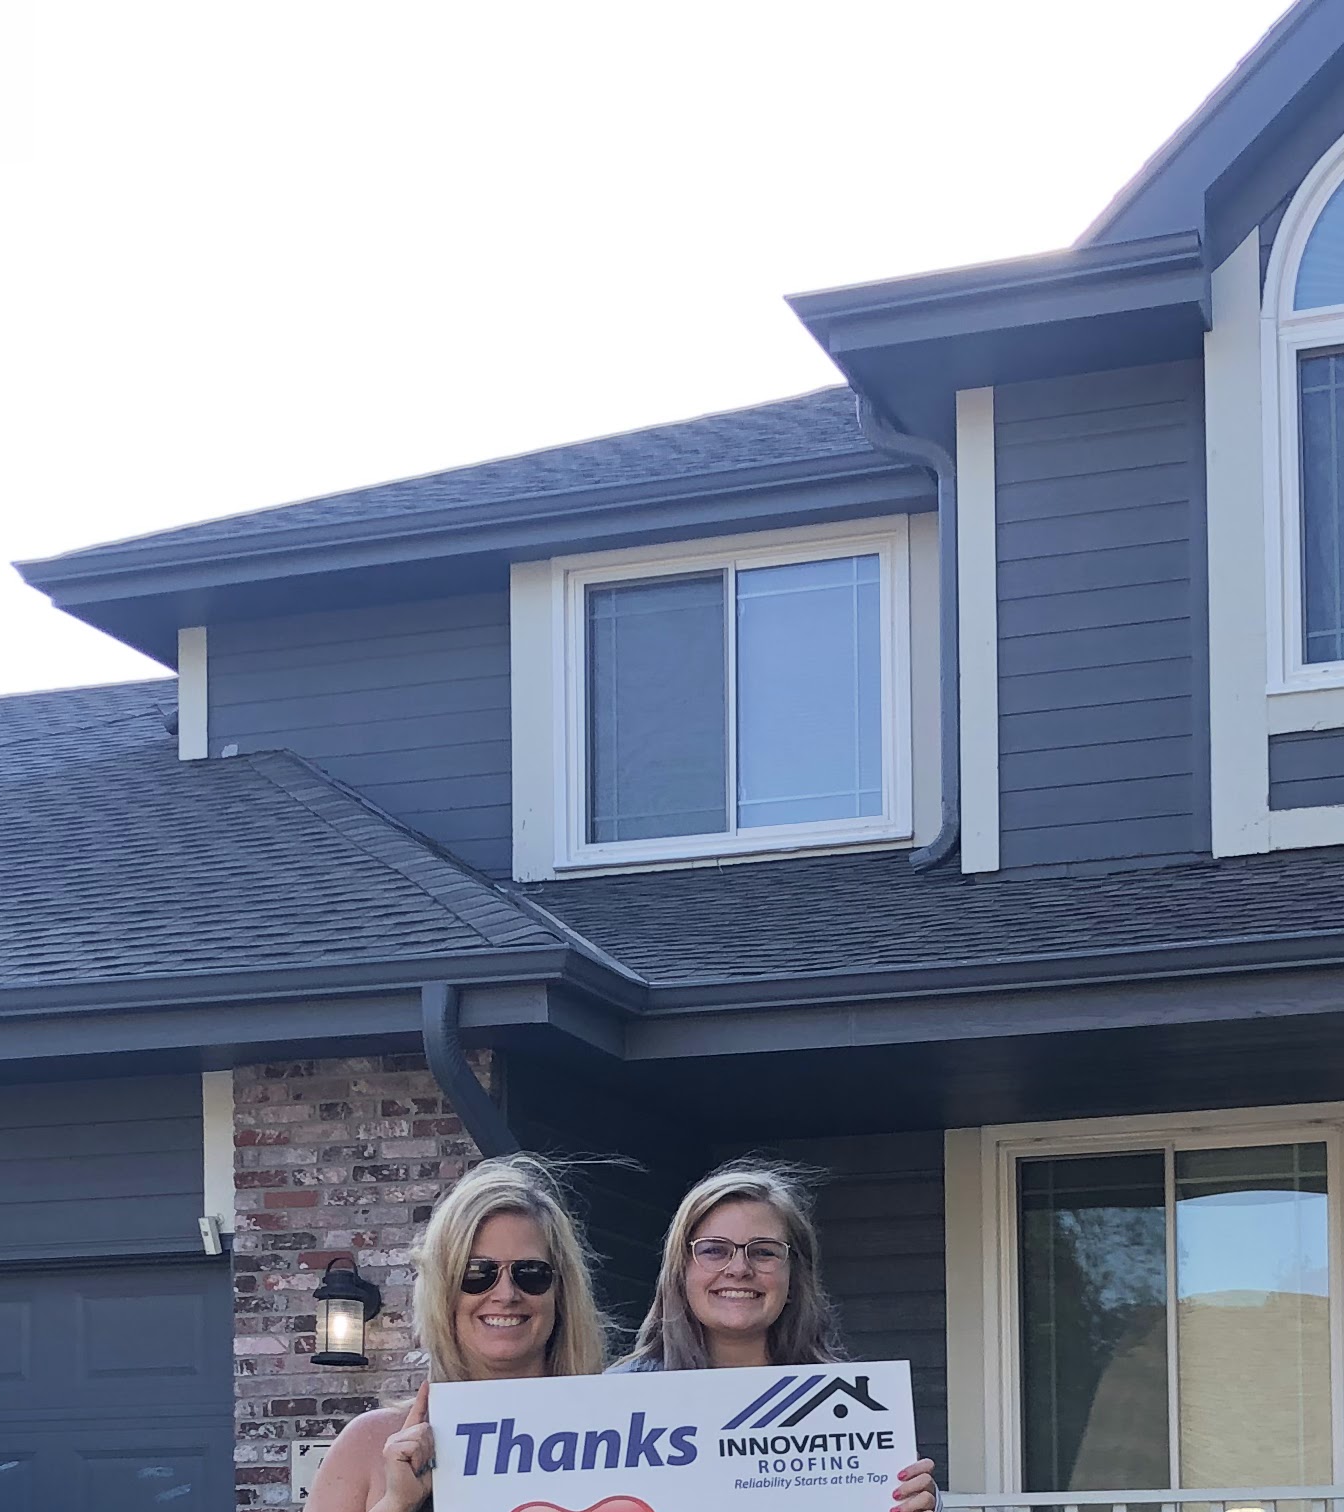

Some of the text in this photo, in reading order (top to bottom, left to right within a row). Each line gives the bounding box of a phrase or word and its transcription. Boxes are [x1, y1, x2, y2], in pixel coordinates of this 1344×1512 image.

[455, 1411, 698, 1477] Thanks
[718, 1430, 895, 1458] INNOVATIVE
[757, 1455, 861, 1474] ROOFING
[734, 1472, 889, 1490] Reliability Starts at the Top
